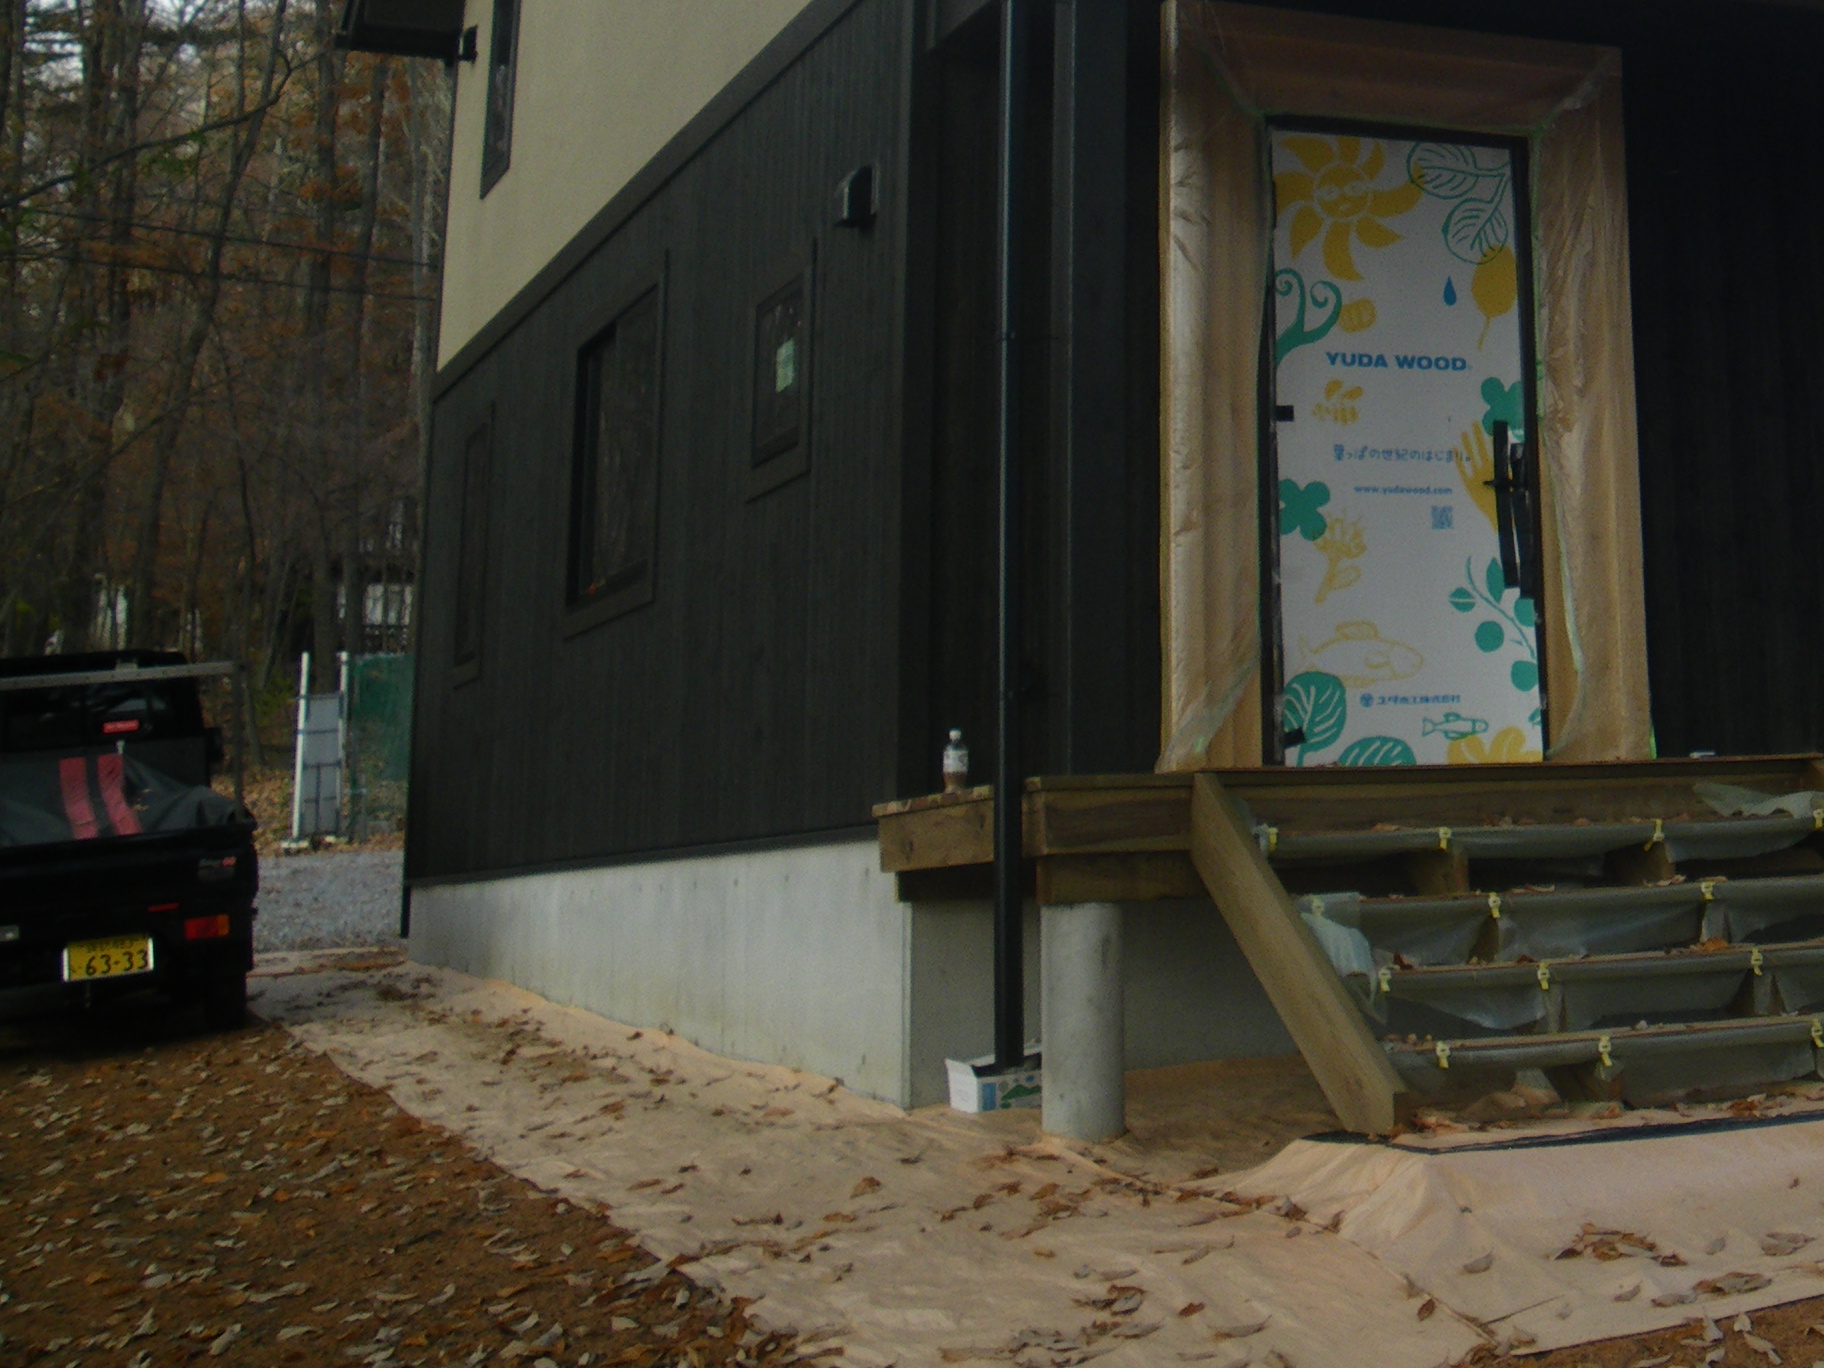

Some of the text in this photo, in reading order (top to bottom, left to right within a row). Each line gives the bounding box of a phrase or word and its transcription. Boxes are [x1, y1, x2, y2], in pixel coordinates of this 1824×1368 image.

[1325, 351, 1467, 371] YUDA WOOD
[1353, 484, 1453, 496] www.yudawood.com
